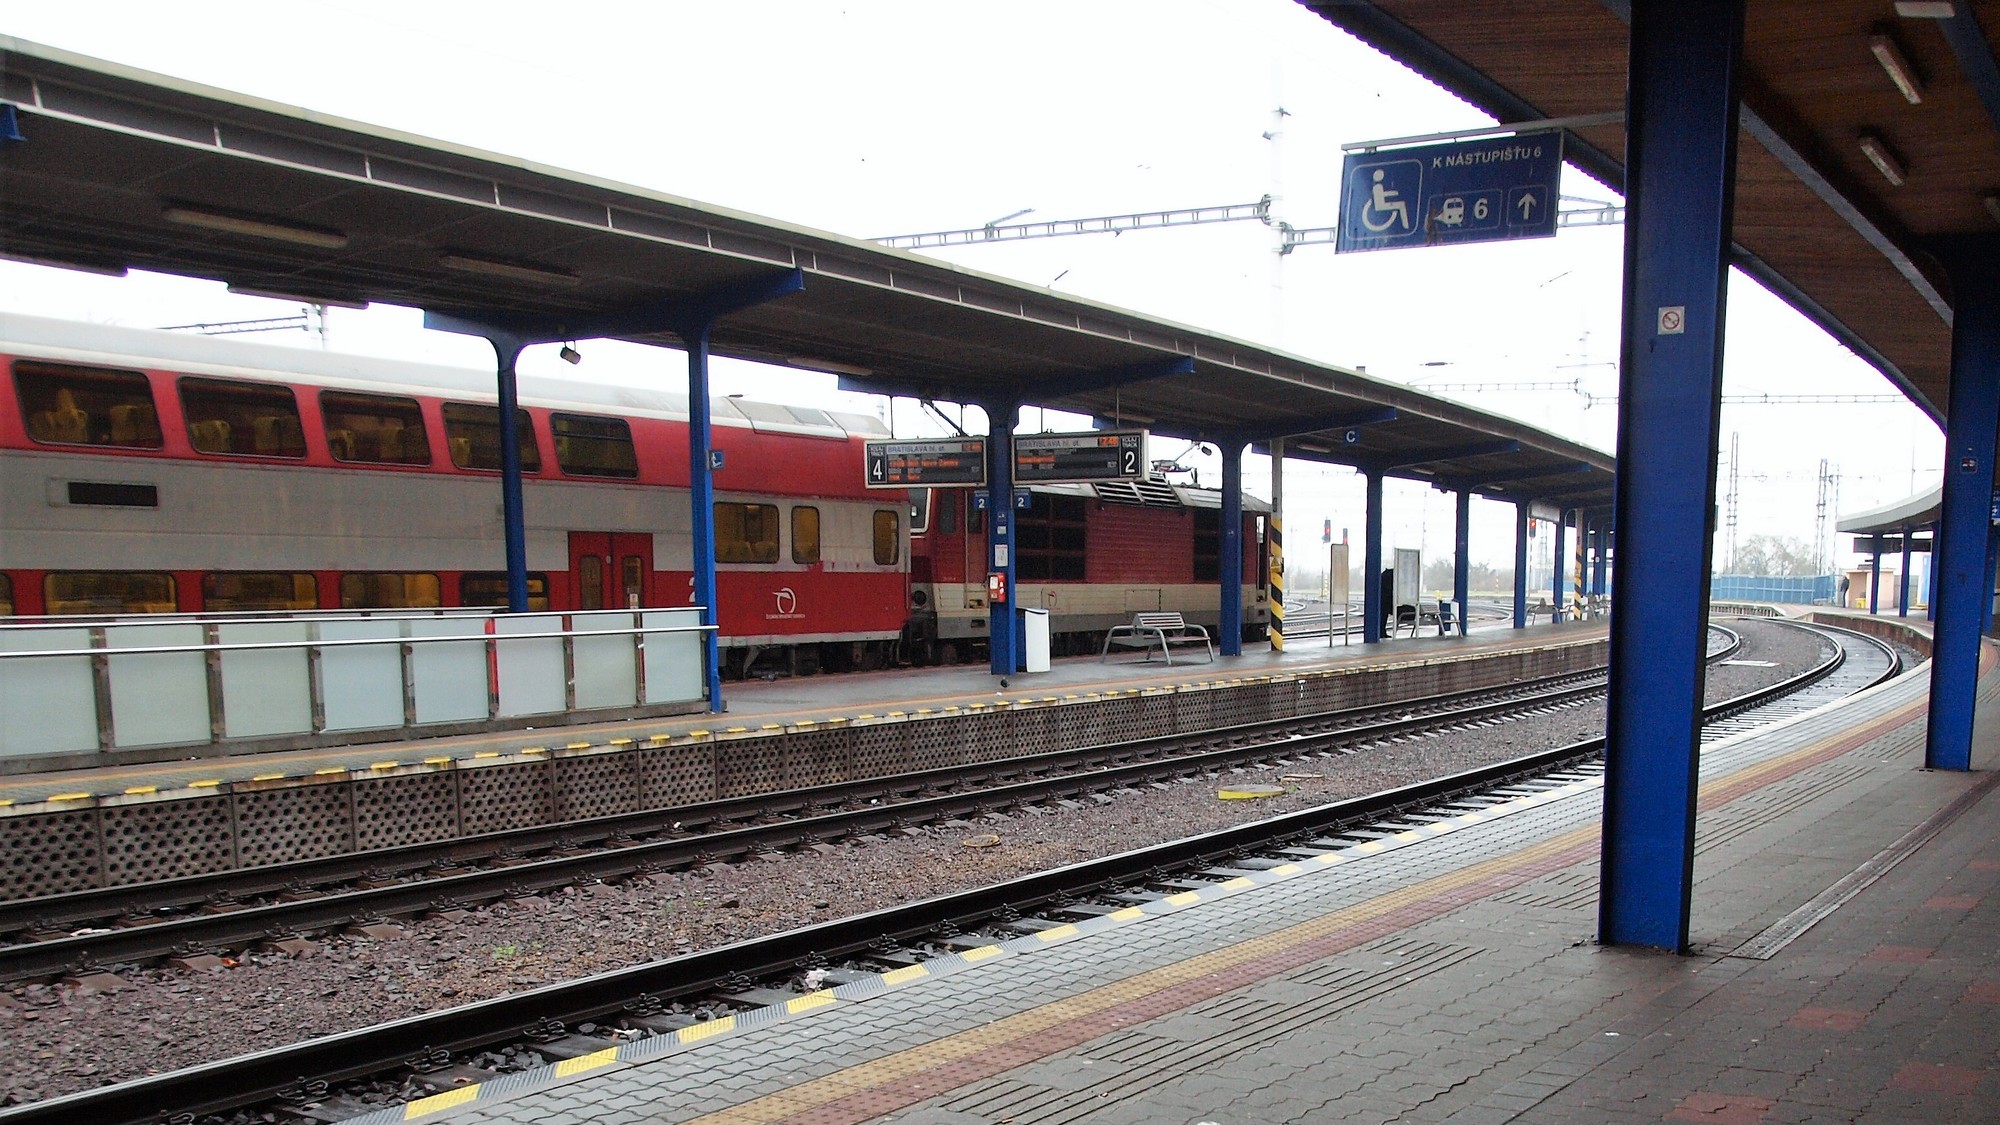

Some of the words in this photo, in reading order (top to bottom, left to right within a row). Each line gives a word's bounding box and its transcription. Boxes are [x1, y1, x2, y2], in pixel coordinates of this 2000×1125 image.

[1432, 157, 1442, 168] K
[1533, 146, 1542, 158] 6
[1474, 198, 1488, 220] 6
[1346, 430, 1356, 443] C
[887, 445, 928, 454] BRATISLAVA
[873, 459, 882, 480] 4
[1125, 451, 1135, 473] 2
[978, 498, 985, 508] 2
[1017, 497, 1025, 507] 2
